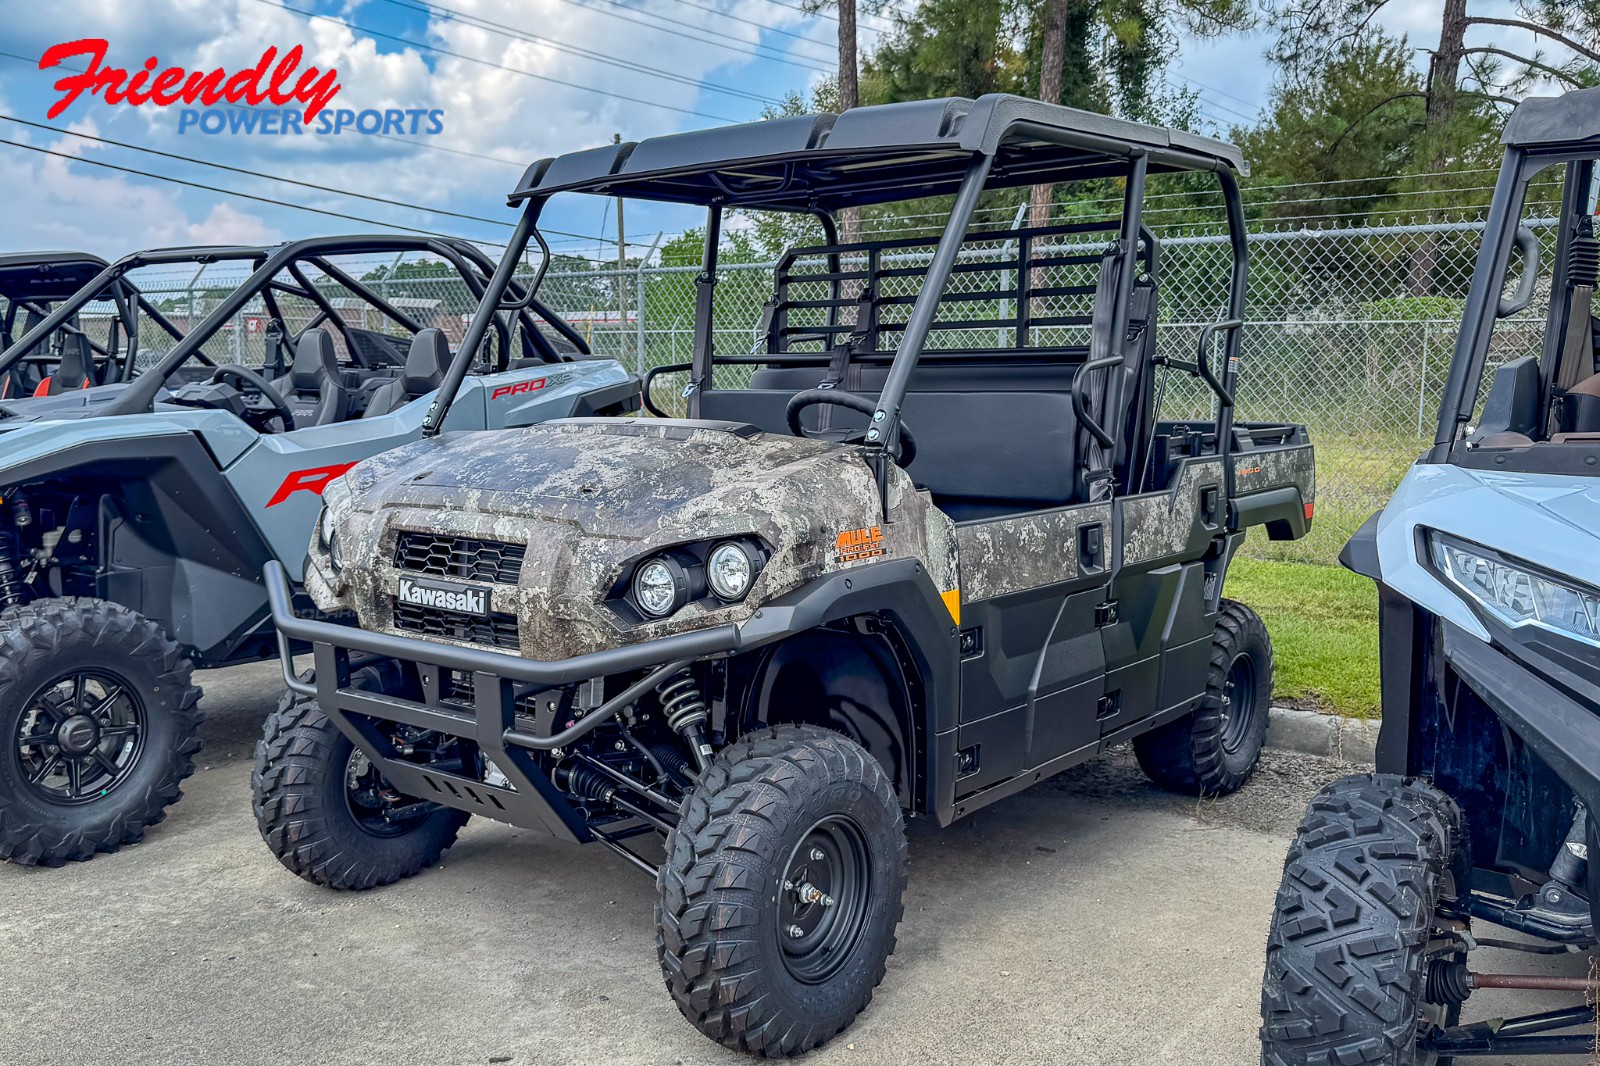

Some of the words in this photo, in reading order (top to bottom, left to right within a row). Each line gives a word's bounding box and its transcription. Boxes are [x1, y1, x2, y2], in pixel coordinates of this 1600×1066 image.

[491, 377, 547, 401] PRO
[835, 526, 884, 548] MULE
[839, 549, 883, 563] 1000
[400, 580, 485, 614] Kawasaki
